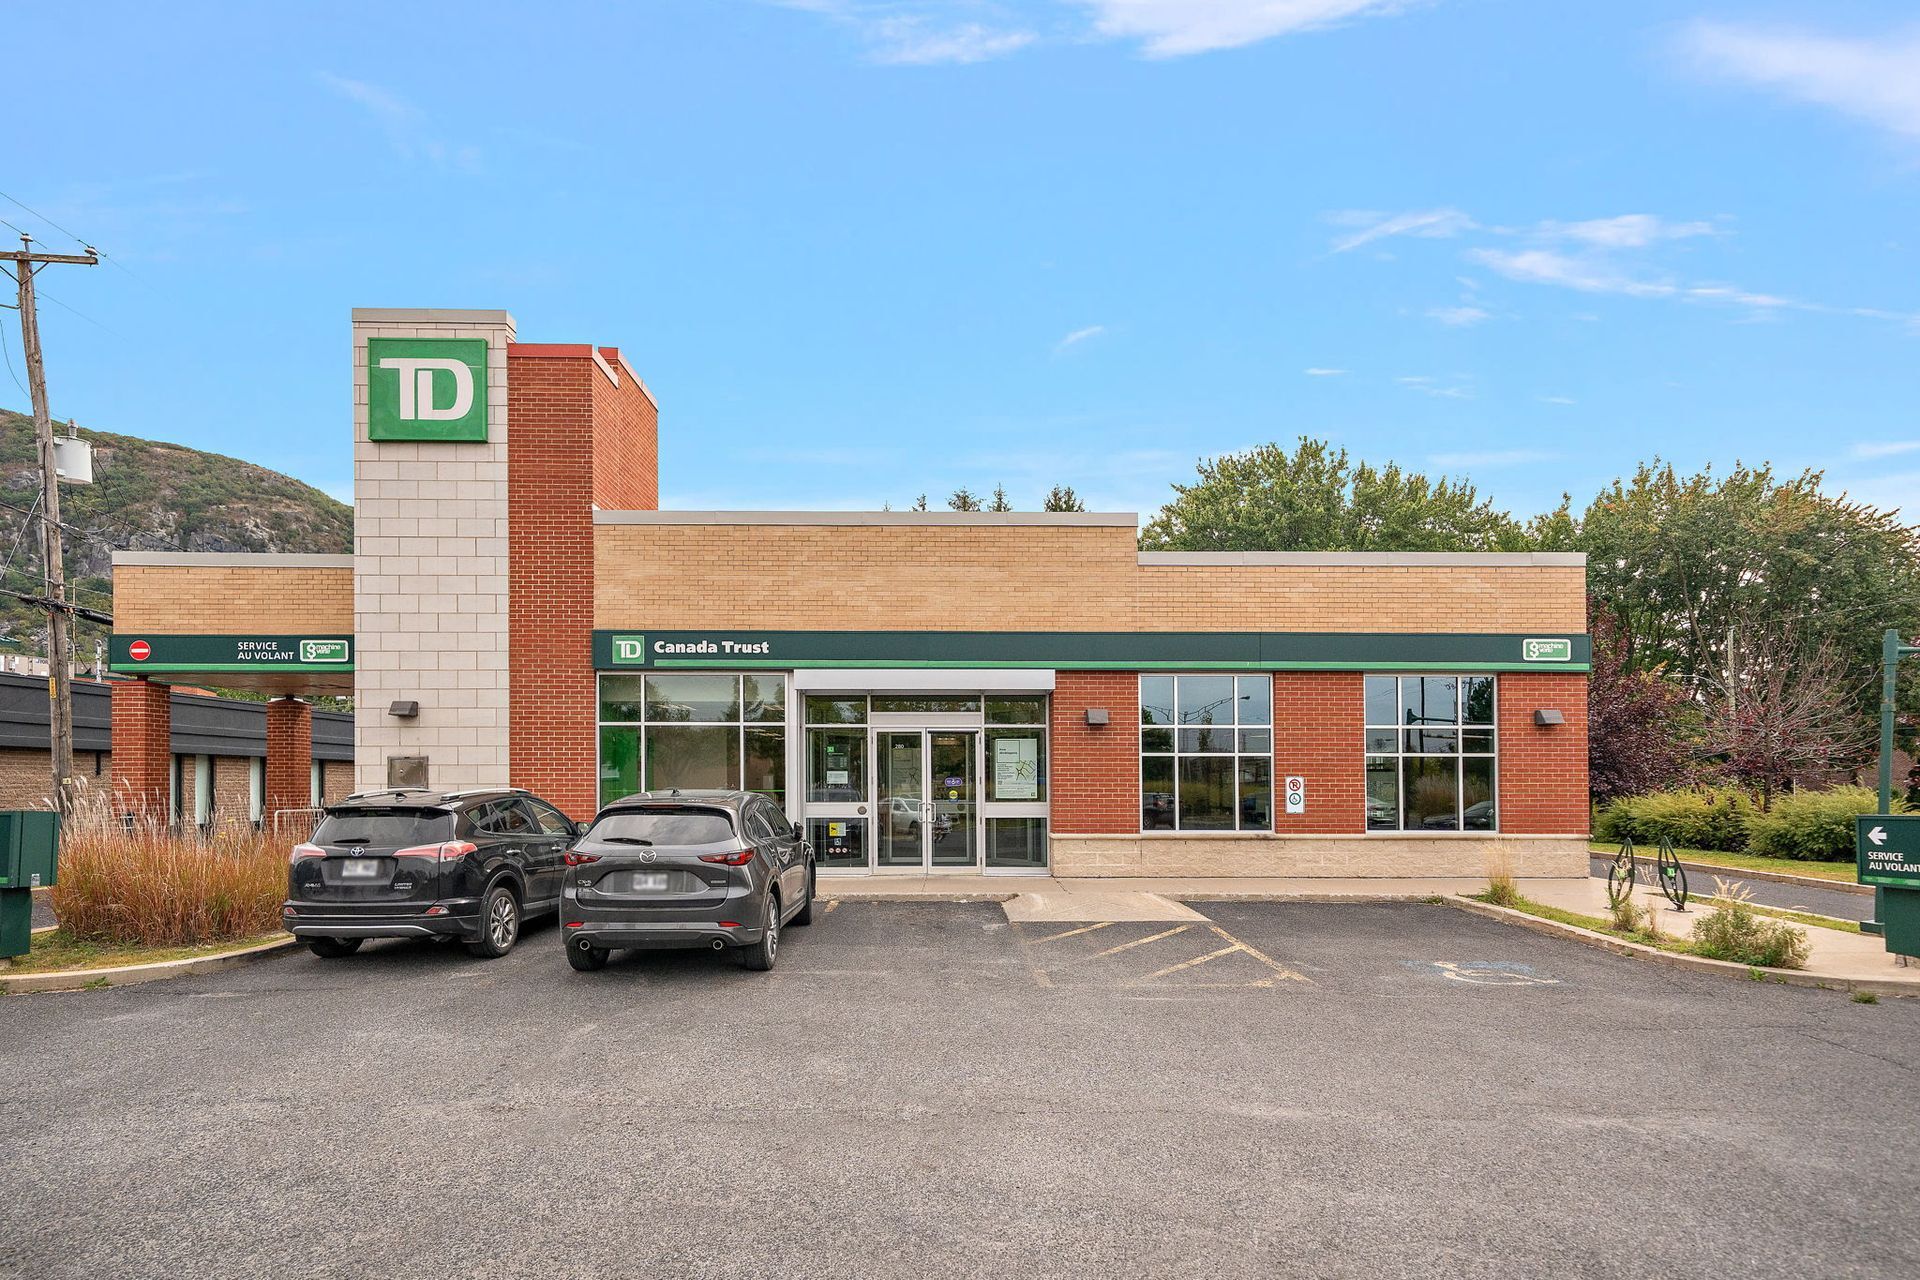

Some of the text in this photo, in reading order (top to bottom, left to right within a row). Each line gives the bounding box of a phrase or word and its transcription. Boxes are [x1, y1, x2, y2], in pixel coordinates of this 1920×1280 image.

[379, 357, 474, 420] TD
[237, 641, 278, 650] SERVICE
[615, 640, 770, 659] TD Canada Trust
[237, 651, 295, 660] AU VOLANT
[1867, 851, 1904, 861] SERVICE
[1868, 862, 1883, 870] AU
